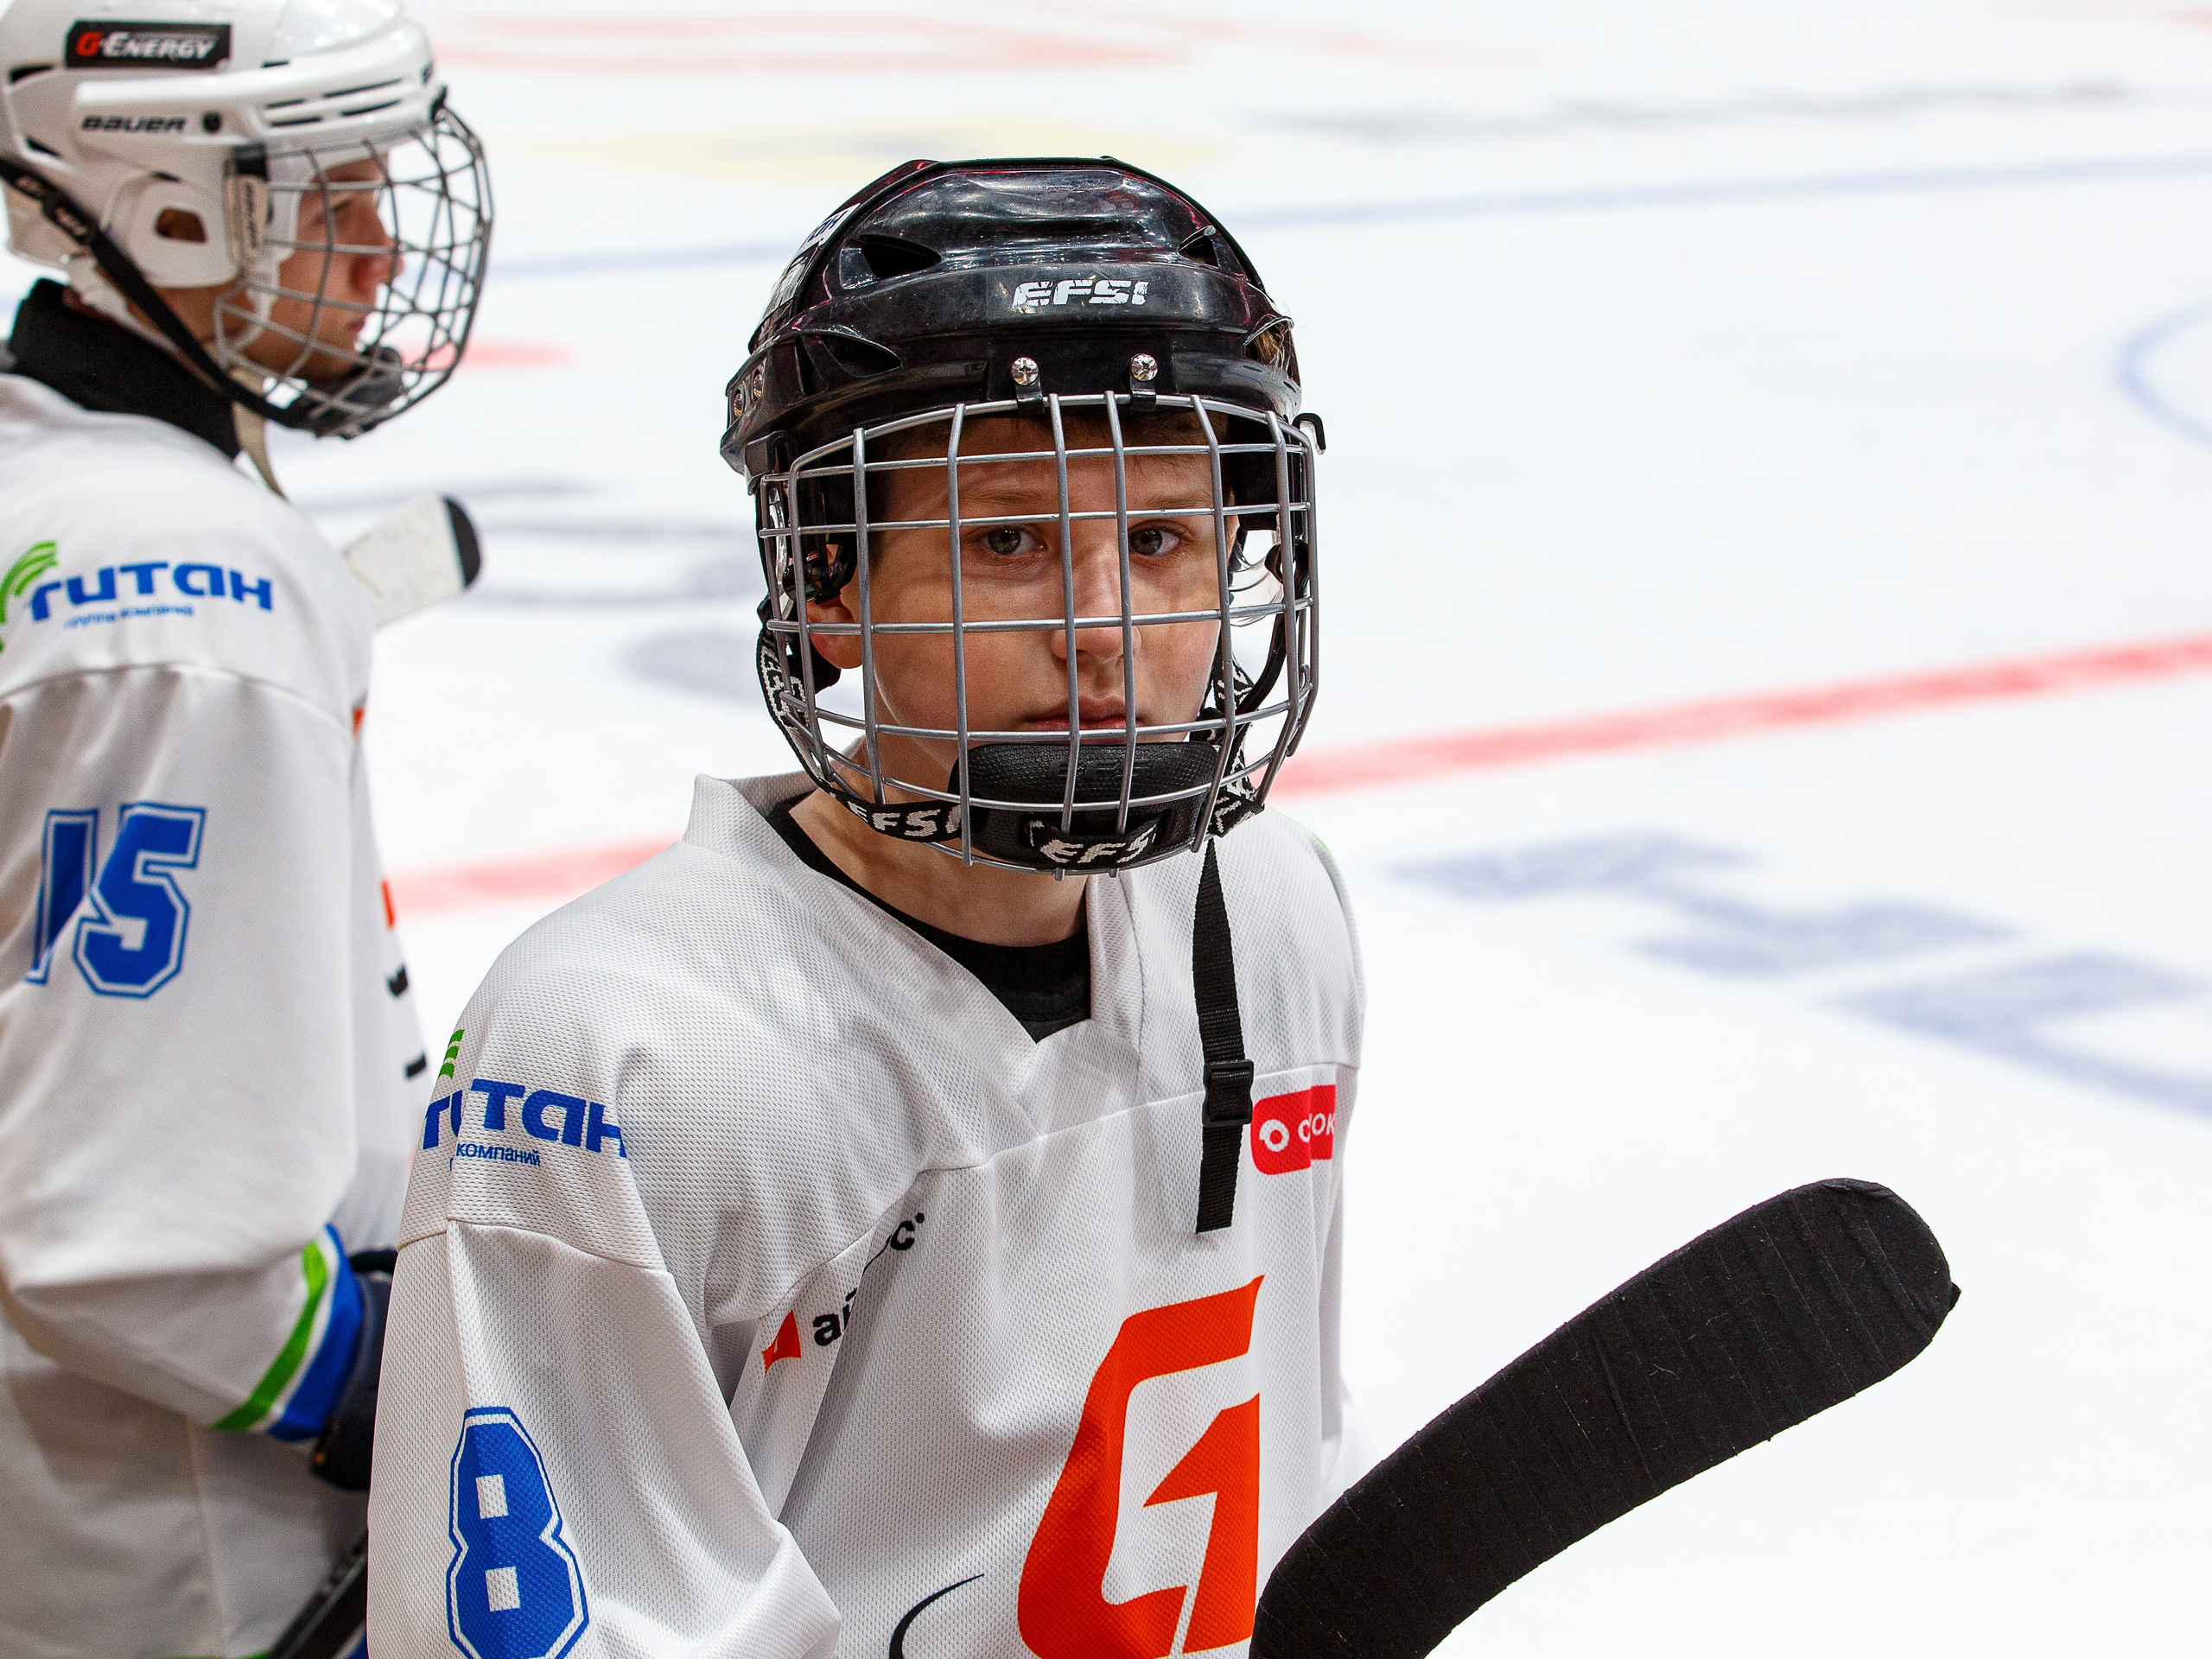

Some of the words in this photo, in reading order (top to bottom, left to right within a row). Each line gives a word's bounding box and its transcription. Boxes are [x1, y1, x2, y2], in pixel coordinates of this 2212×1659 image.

[1012, 279, 1149, 308] EFSI
[1039, 823, 1157, 864] EFS
[24, 800, 207, 1000] 15
[456, 1142, 541, 1167] компаний
[446, 1406, 589, 1659] 8
